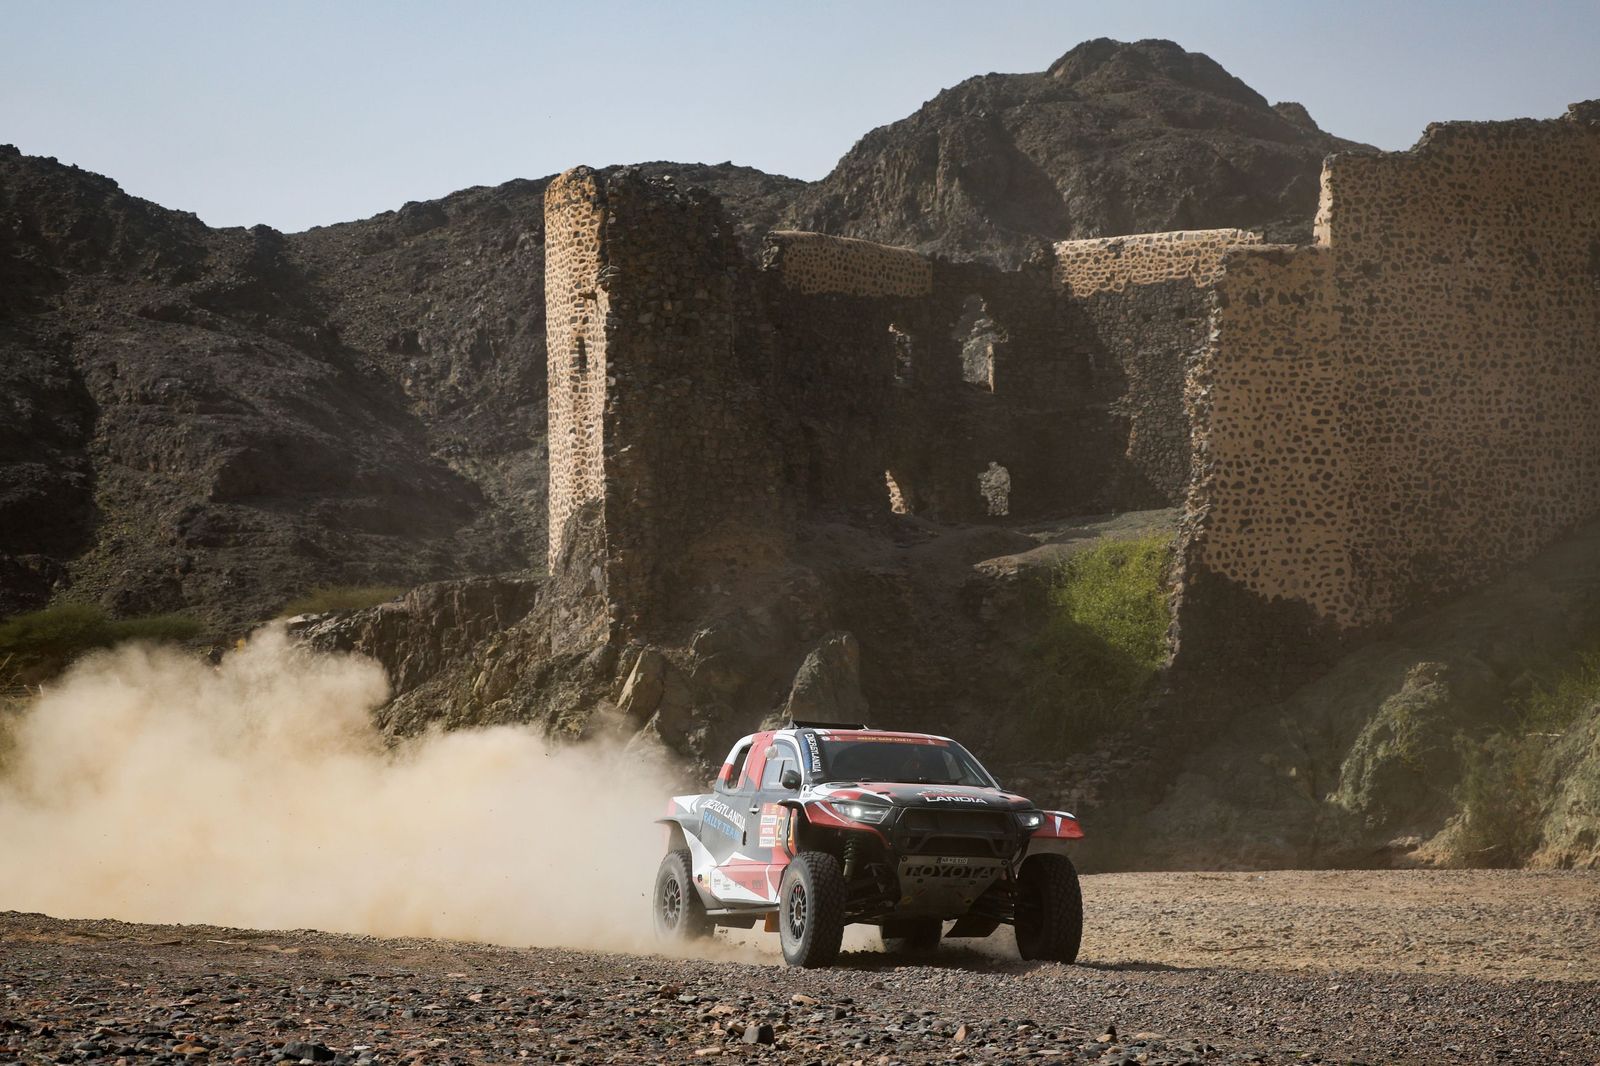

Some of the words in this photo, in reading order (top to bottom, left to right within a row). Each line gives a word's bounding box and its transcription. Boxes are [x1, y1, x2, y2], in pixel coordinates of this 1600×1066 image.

[925, 796, 988, 804] LANDIA
[704, 811, 722, 830] RALLY
[907, 865, 994, 878] TOYOTA
